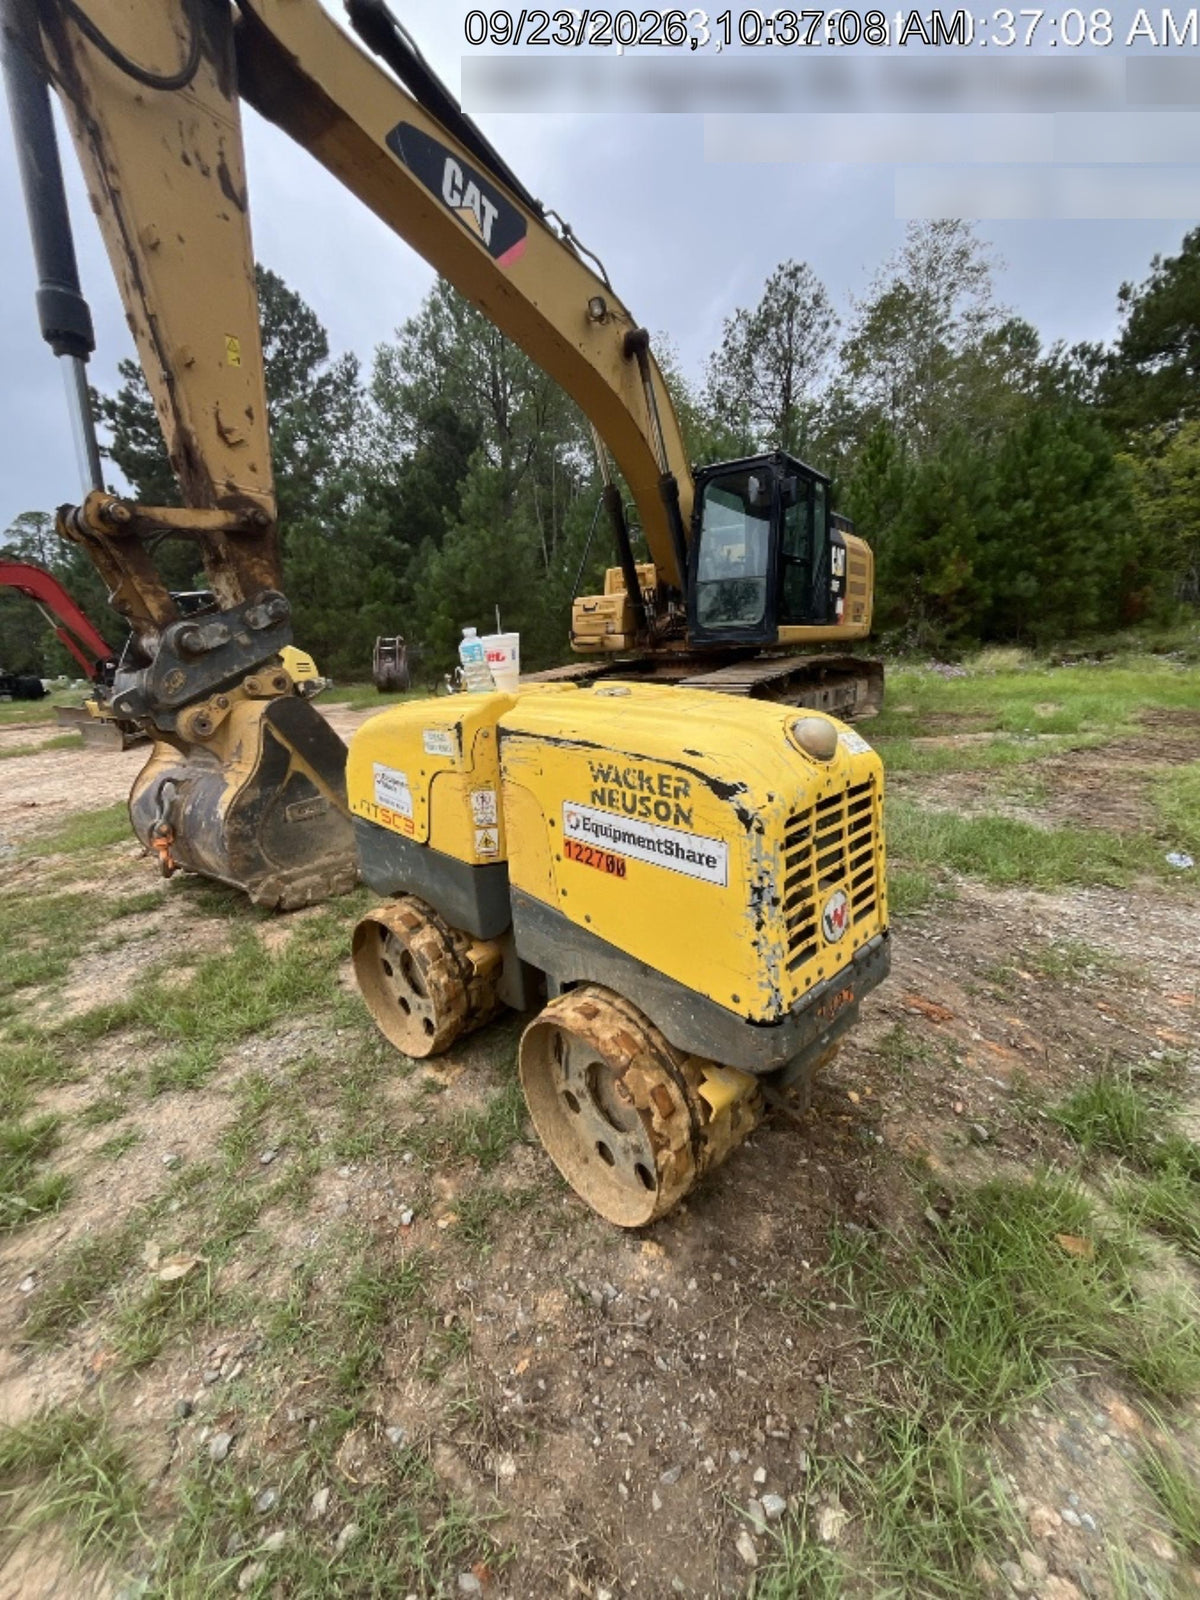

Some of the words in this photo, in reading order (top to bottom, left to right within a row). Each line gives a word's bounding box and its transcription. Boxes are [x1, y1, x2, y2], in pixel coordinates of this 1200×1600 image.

[442, 157, 499, 247] CAT
[588, 760, 692, 800] WACKER
[590, 787, 694, 829] NEUSON
[582, 816, 718, 870] EquipmentShare
